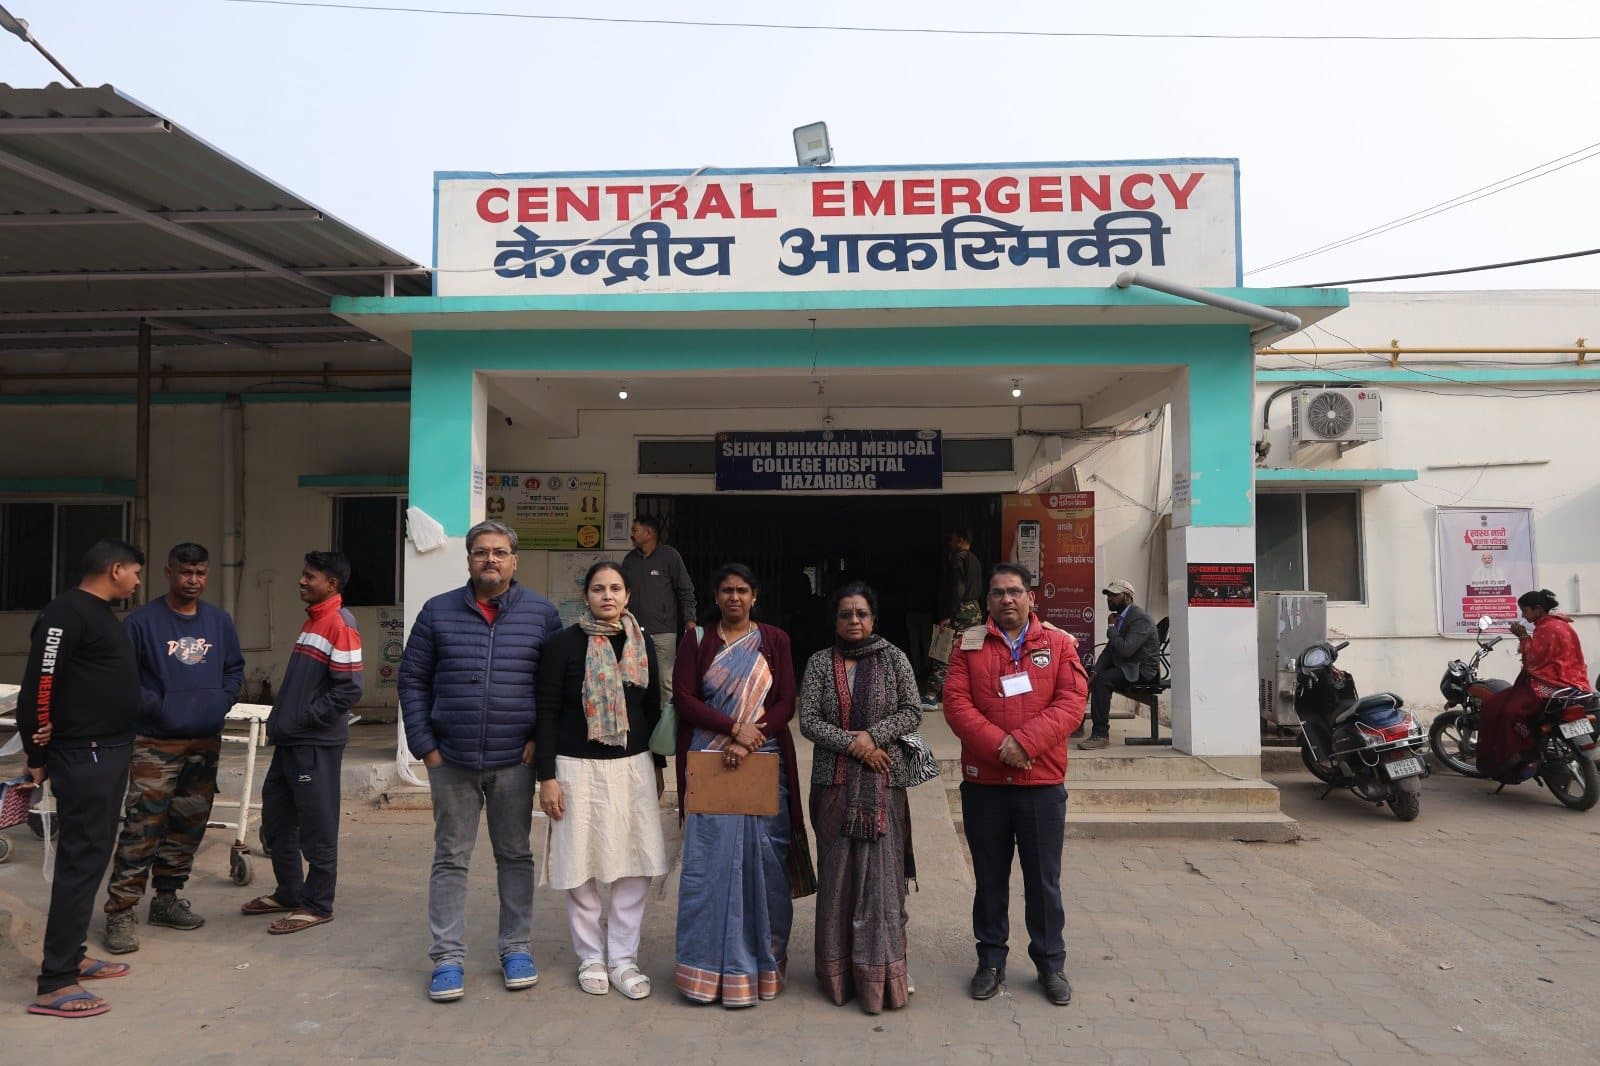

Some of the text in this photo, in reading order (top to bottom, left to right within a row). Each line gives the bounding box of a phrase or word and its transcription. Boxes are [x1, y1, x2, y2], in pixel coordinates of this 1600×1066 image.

[476, 173, 1206, 224] CENTRAL EMERGENCY
[494, 210, 1171, 287] केन्द्रीय आकस्मिकी
[722, 440, 935, 456] SEIKH BHIKHARI MEDICAL
[752, 457, 906, 472] COLLEGE HOSPITAL
[781, 474, 877, 489] HAZARIBAG
[41, 627, 63, 674] COVERT
[167, 638, 213, 660] DESERT
